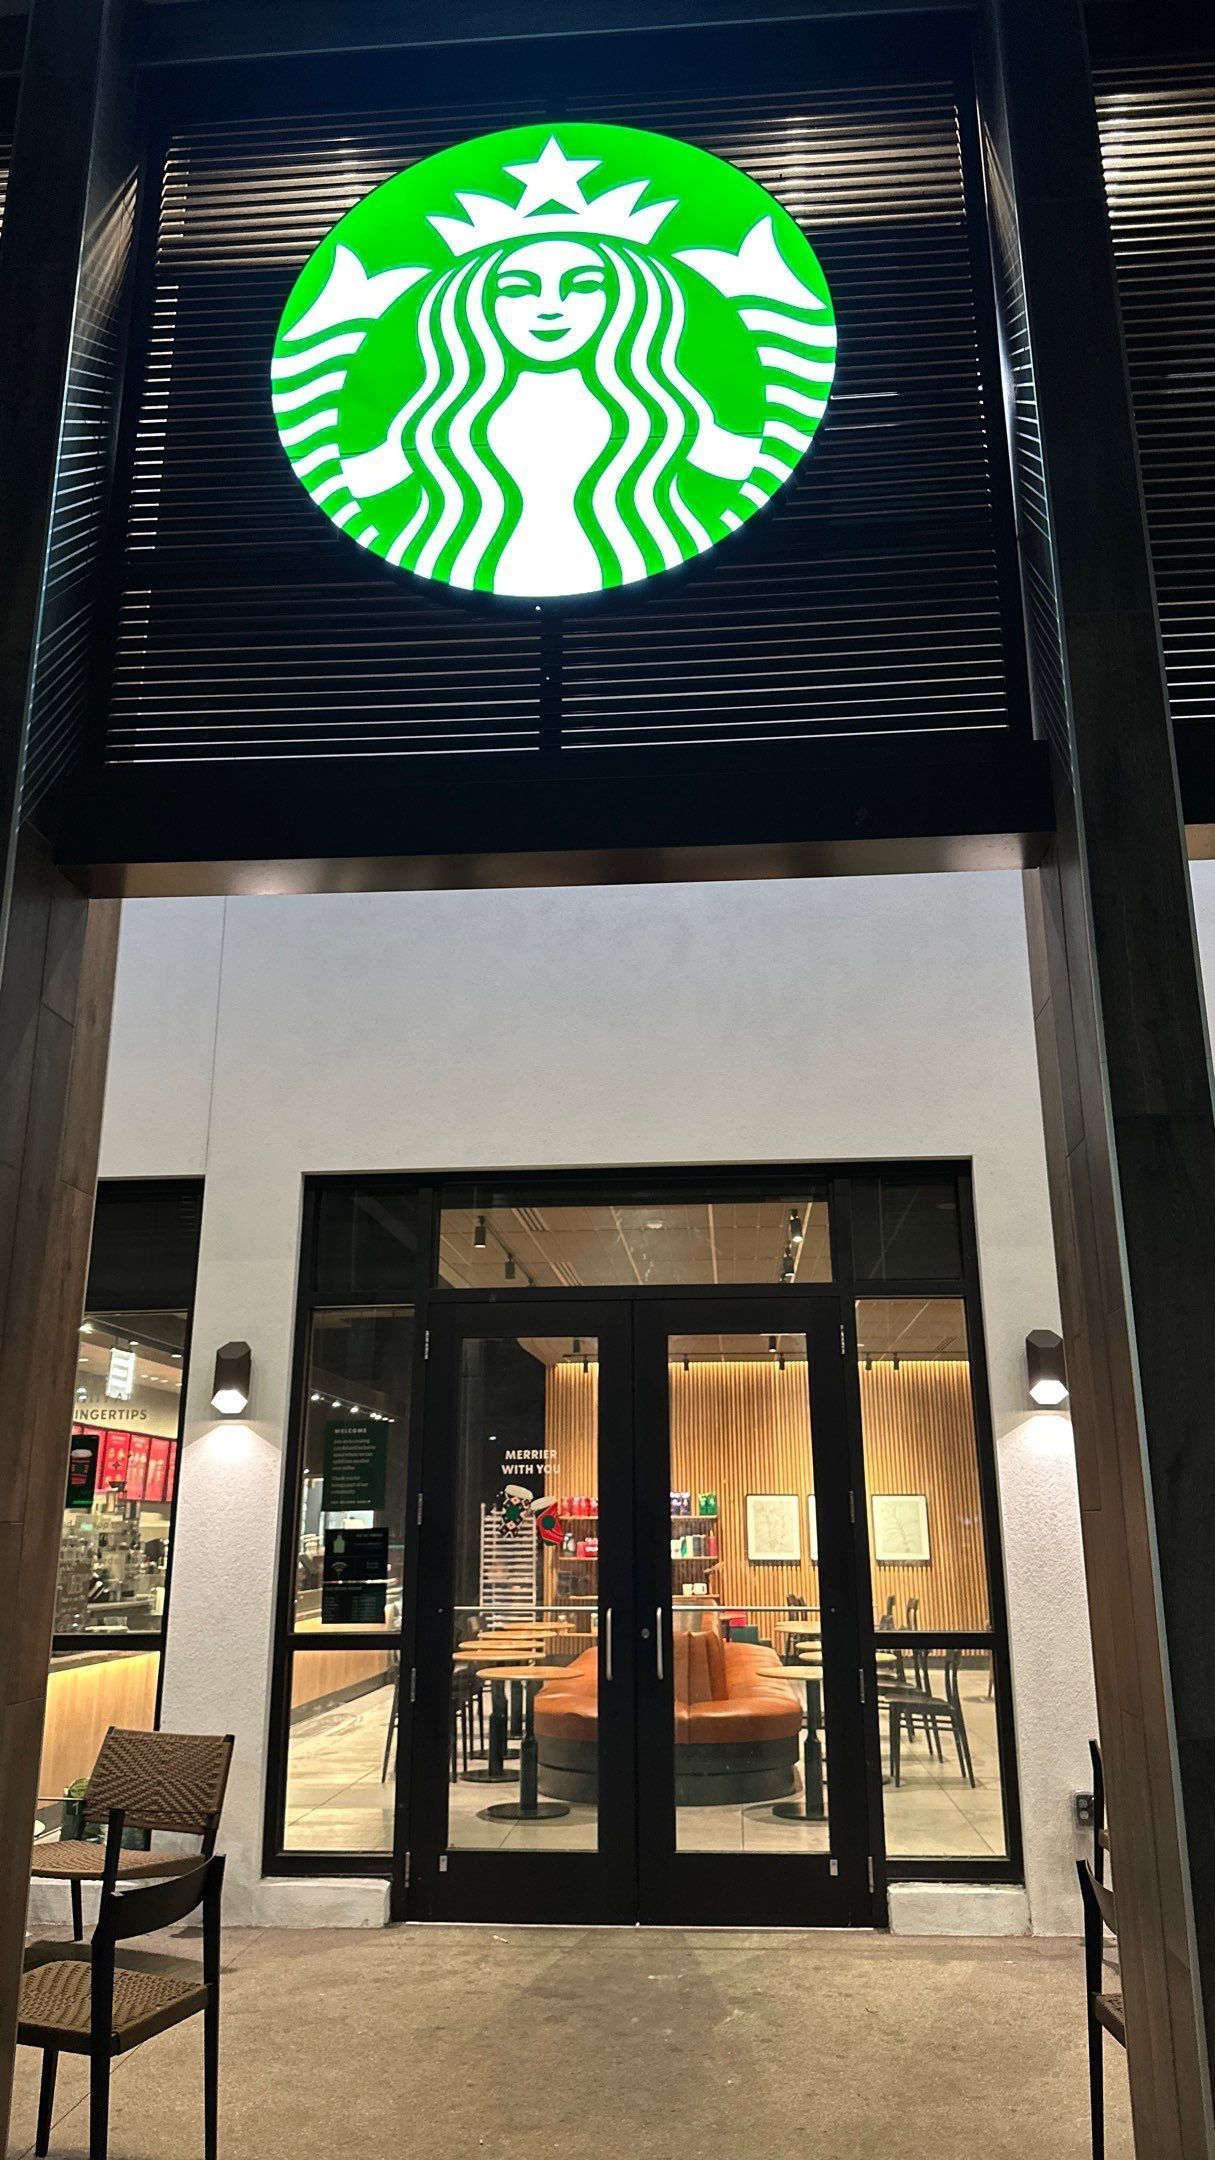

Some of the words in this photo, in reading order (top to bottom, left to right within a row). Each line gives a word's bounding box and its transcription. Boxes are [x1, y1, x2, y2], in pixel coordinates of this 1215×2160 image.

[74, 1409, 147, 1420] INGERTIPS
[505, 1449, 557, 1460] MERRIER
[501, 1464, 534, 1475] WITH
[536, 1464, 561, 1475] YOU
